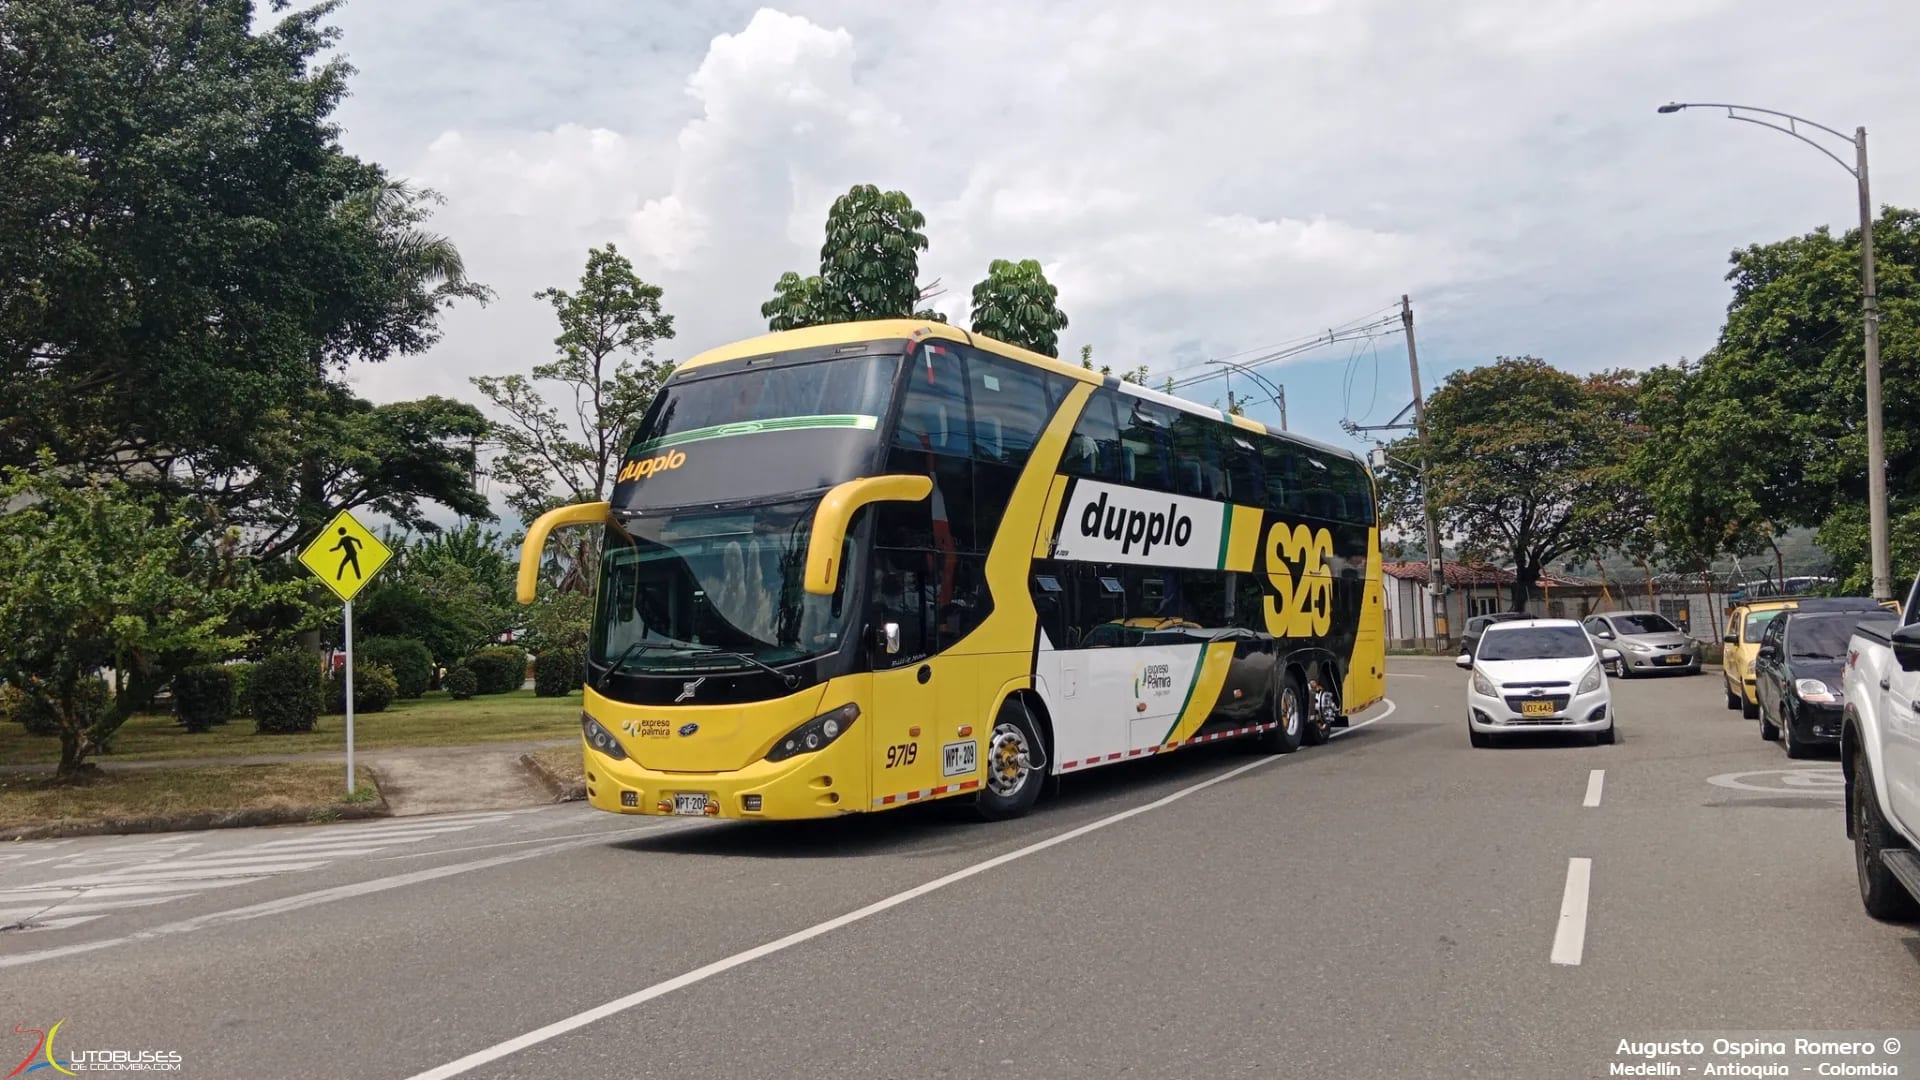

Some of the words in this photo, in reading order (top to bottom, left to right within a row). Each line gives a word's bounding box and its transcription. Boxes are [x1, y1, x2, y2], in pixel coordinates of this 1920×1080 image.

[618, 449, 686, 484] dupplo
[1080, 492, 1192, 556] dupplo
[1263, 521, 1334, 638] S26
[641, 719, 670, 728] expreso
[641, 728, 670, 737] palmira
[885, 742, 918, 769] 9719
